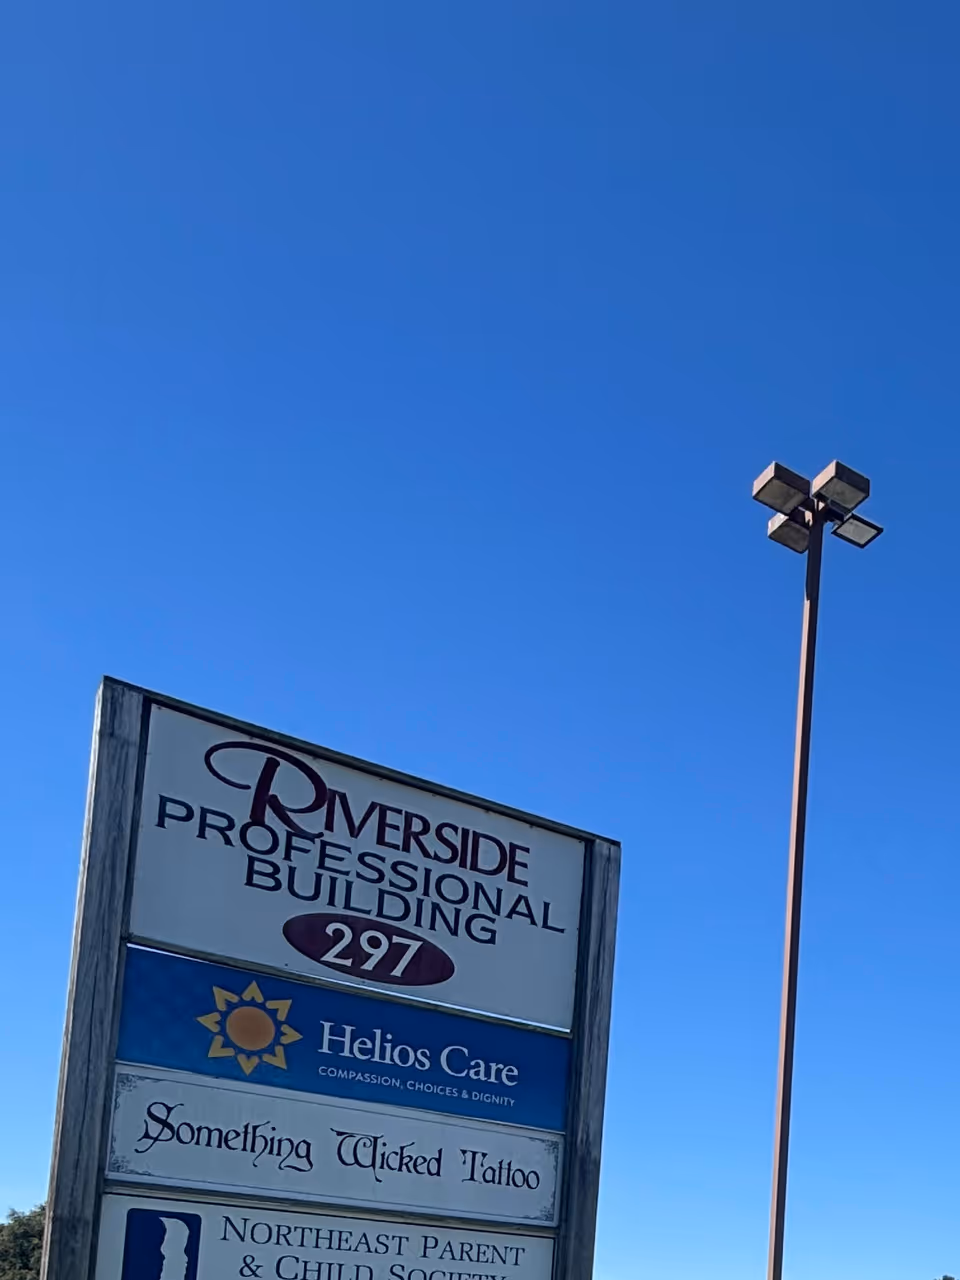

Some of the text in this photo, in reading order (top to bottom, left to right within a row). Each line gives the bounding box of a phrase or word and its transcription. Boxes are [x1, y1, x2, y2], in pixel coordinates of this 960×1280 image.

[205, 741, 530, 887] RIVERSIDE
[155, 794, 566, 933] PROFESSIONAL
[244, 854, 498, 945] BUILDING
[319, 921, 423, 977] 297
[318, 1021, 519, 1086] Helios Care
[318, 1066, 515, 1107] COMPASSION, CHOICES & DIGNITY
[134, 1101, 540, 1189] Something Wicked Tattoo
[220, 1215, 525, 1266] NORTHEAST PARENT
[238, 1254, 263, 1279] &
